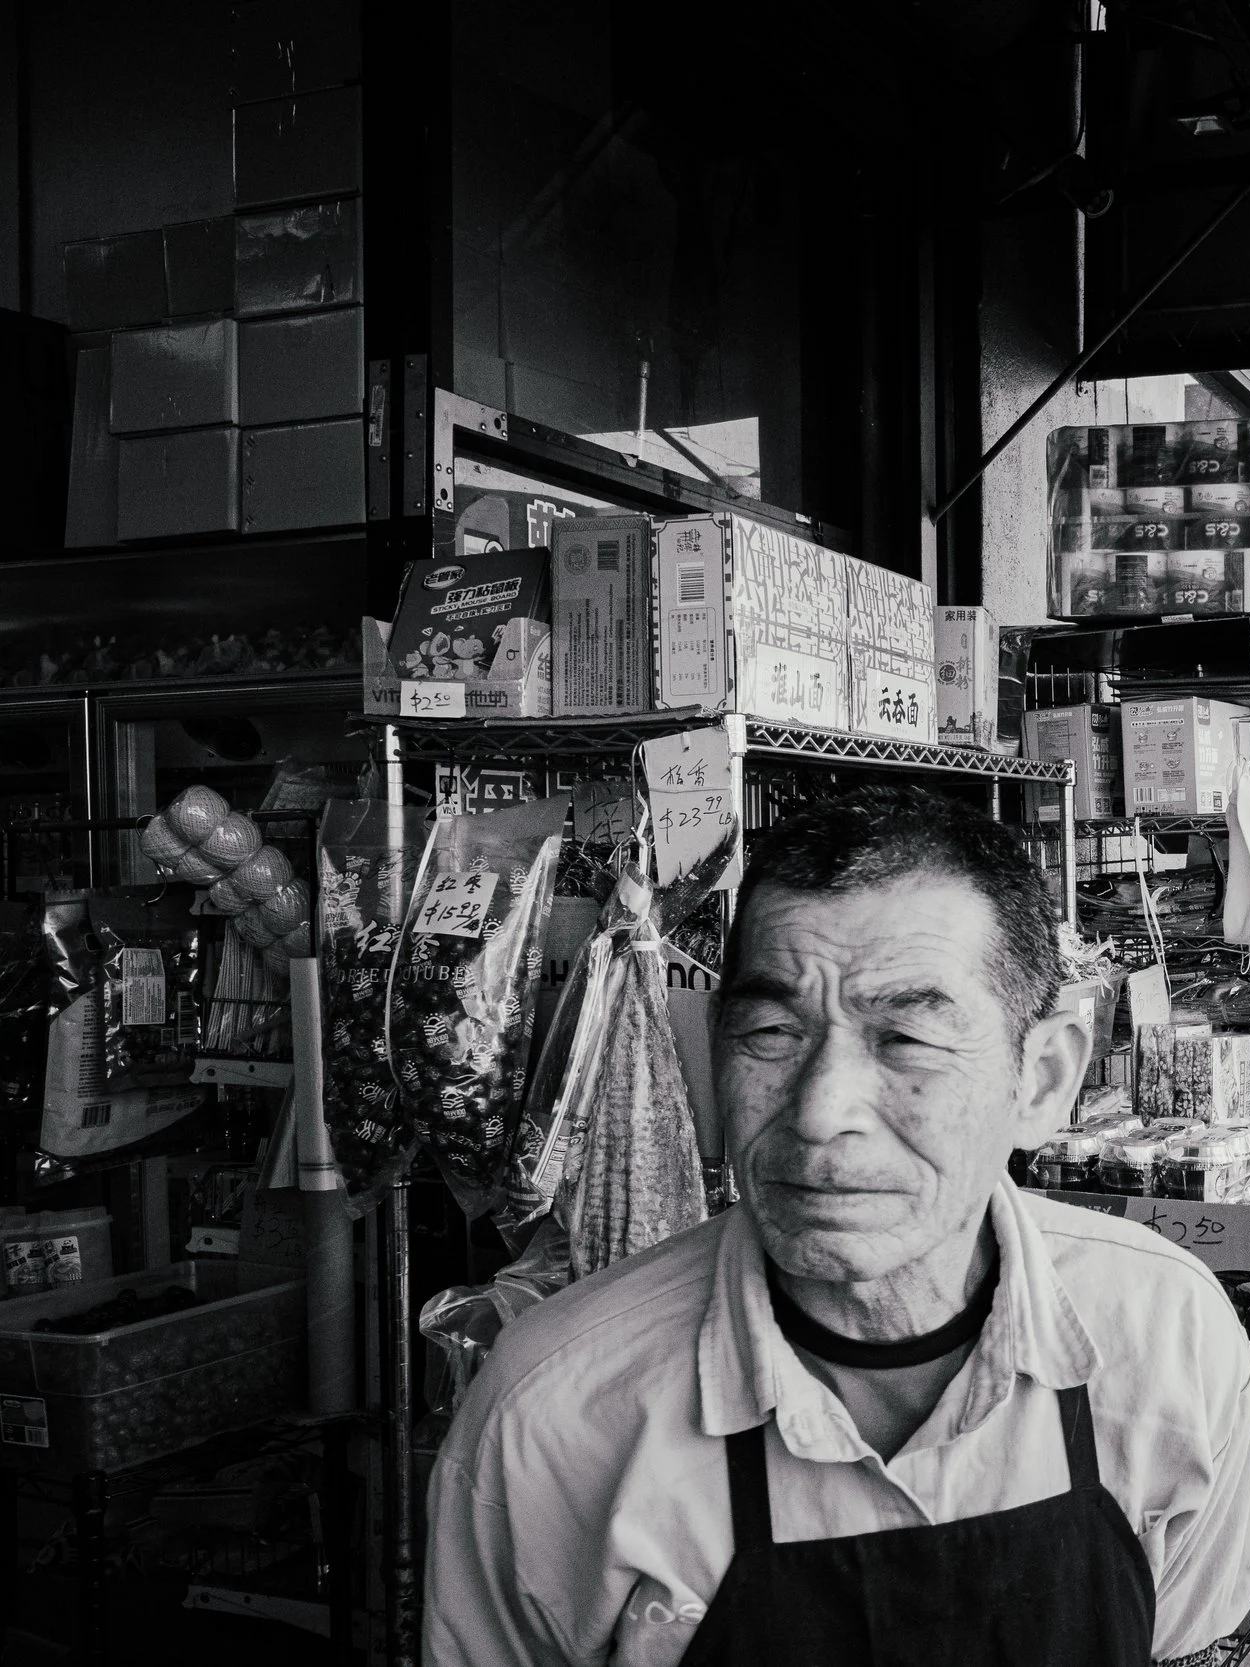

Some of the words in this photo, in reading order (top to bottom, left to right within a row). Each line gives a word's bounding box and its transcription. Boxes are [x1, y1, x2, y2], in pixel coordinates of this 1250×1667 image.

[1134, 523, 1169, 538] C&S
[1204, 522, 1241, 537] C&S
[432, 604, 458, 614] STICKY
[460, 599, 488, 609] MOUSE
[490, 592, 517, 602] BOARD
[1175, 590, 1209, 604] C&S
[944, 609, 977, 621] 家用装
[879, 686, 919, 729] 云吞面
[718, 812, 733, 826] LB
